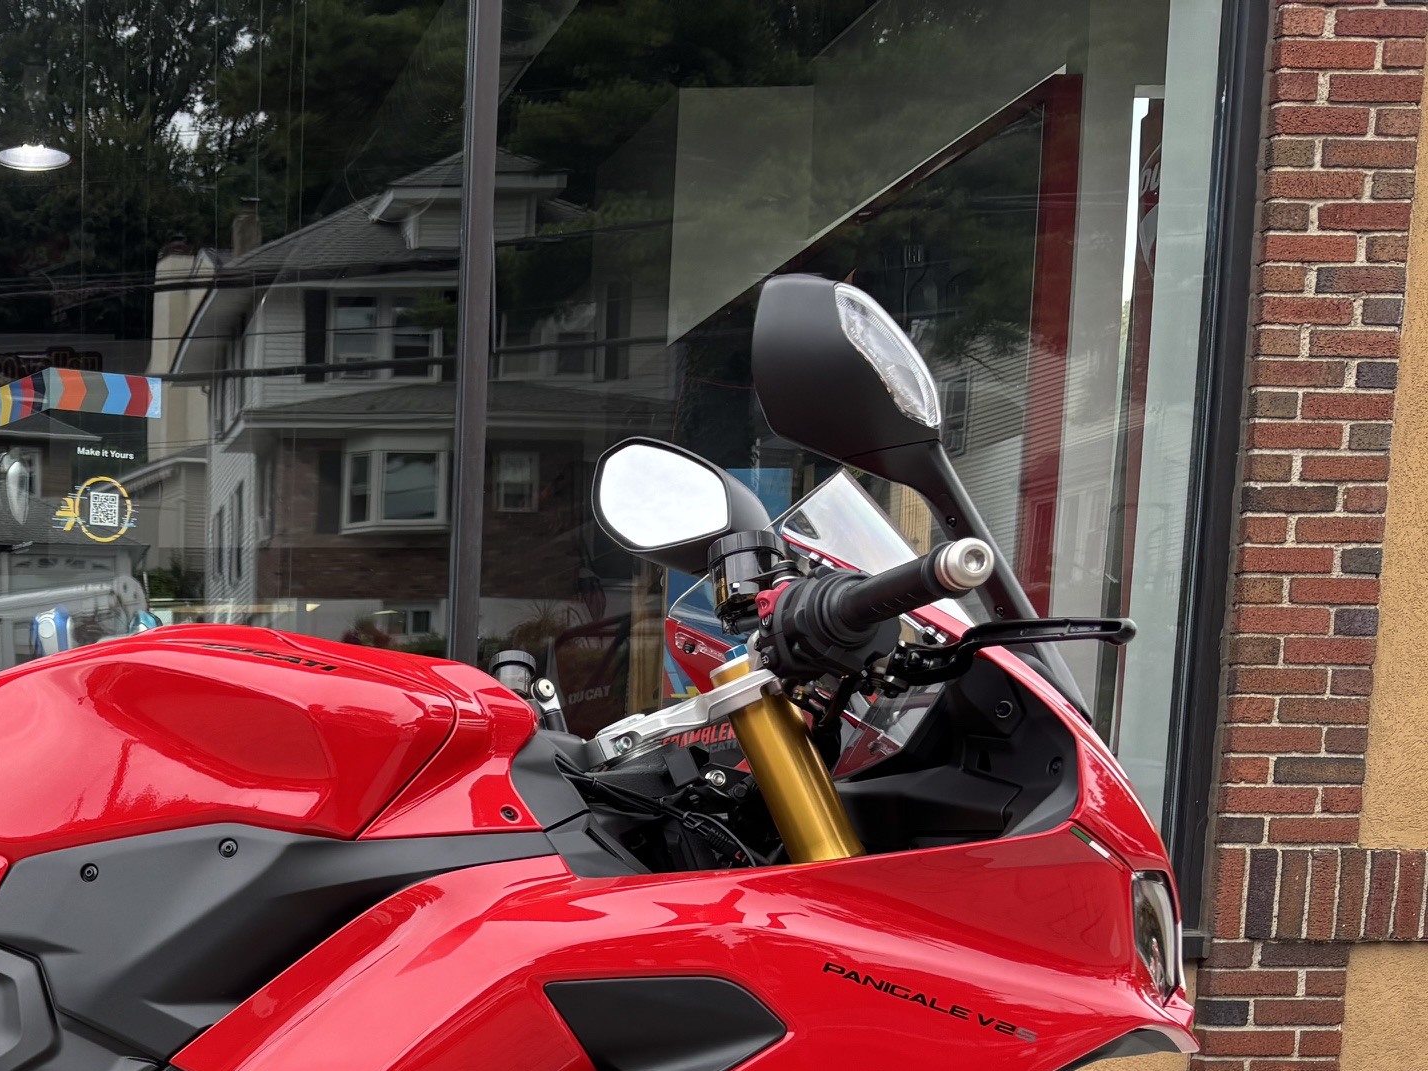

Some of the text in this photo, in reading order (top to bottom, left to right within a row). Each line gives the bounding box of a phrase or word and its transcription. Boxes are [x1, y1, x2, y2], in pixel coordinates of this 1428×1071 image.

[77, 446, 134, 460] Make it Yours
[822, 962, 972, 1021] PANIGALE
